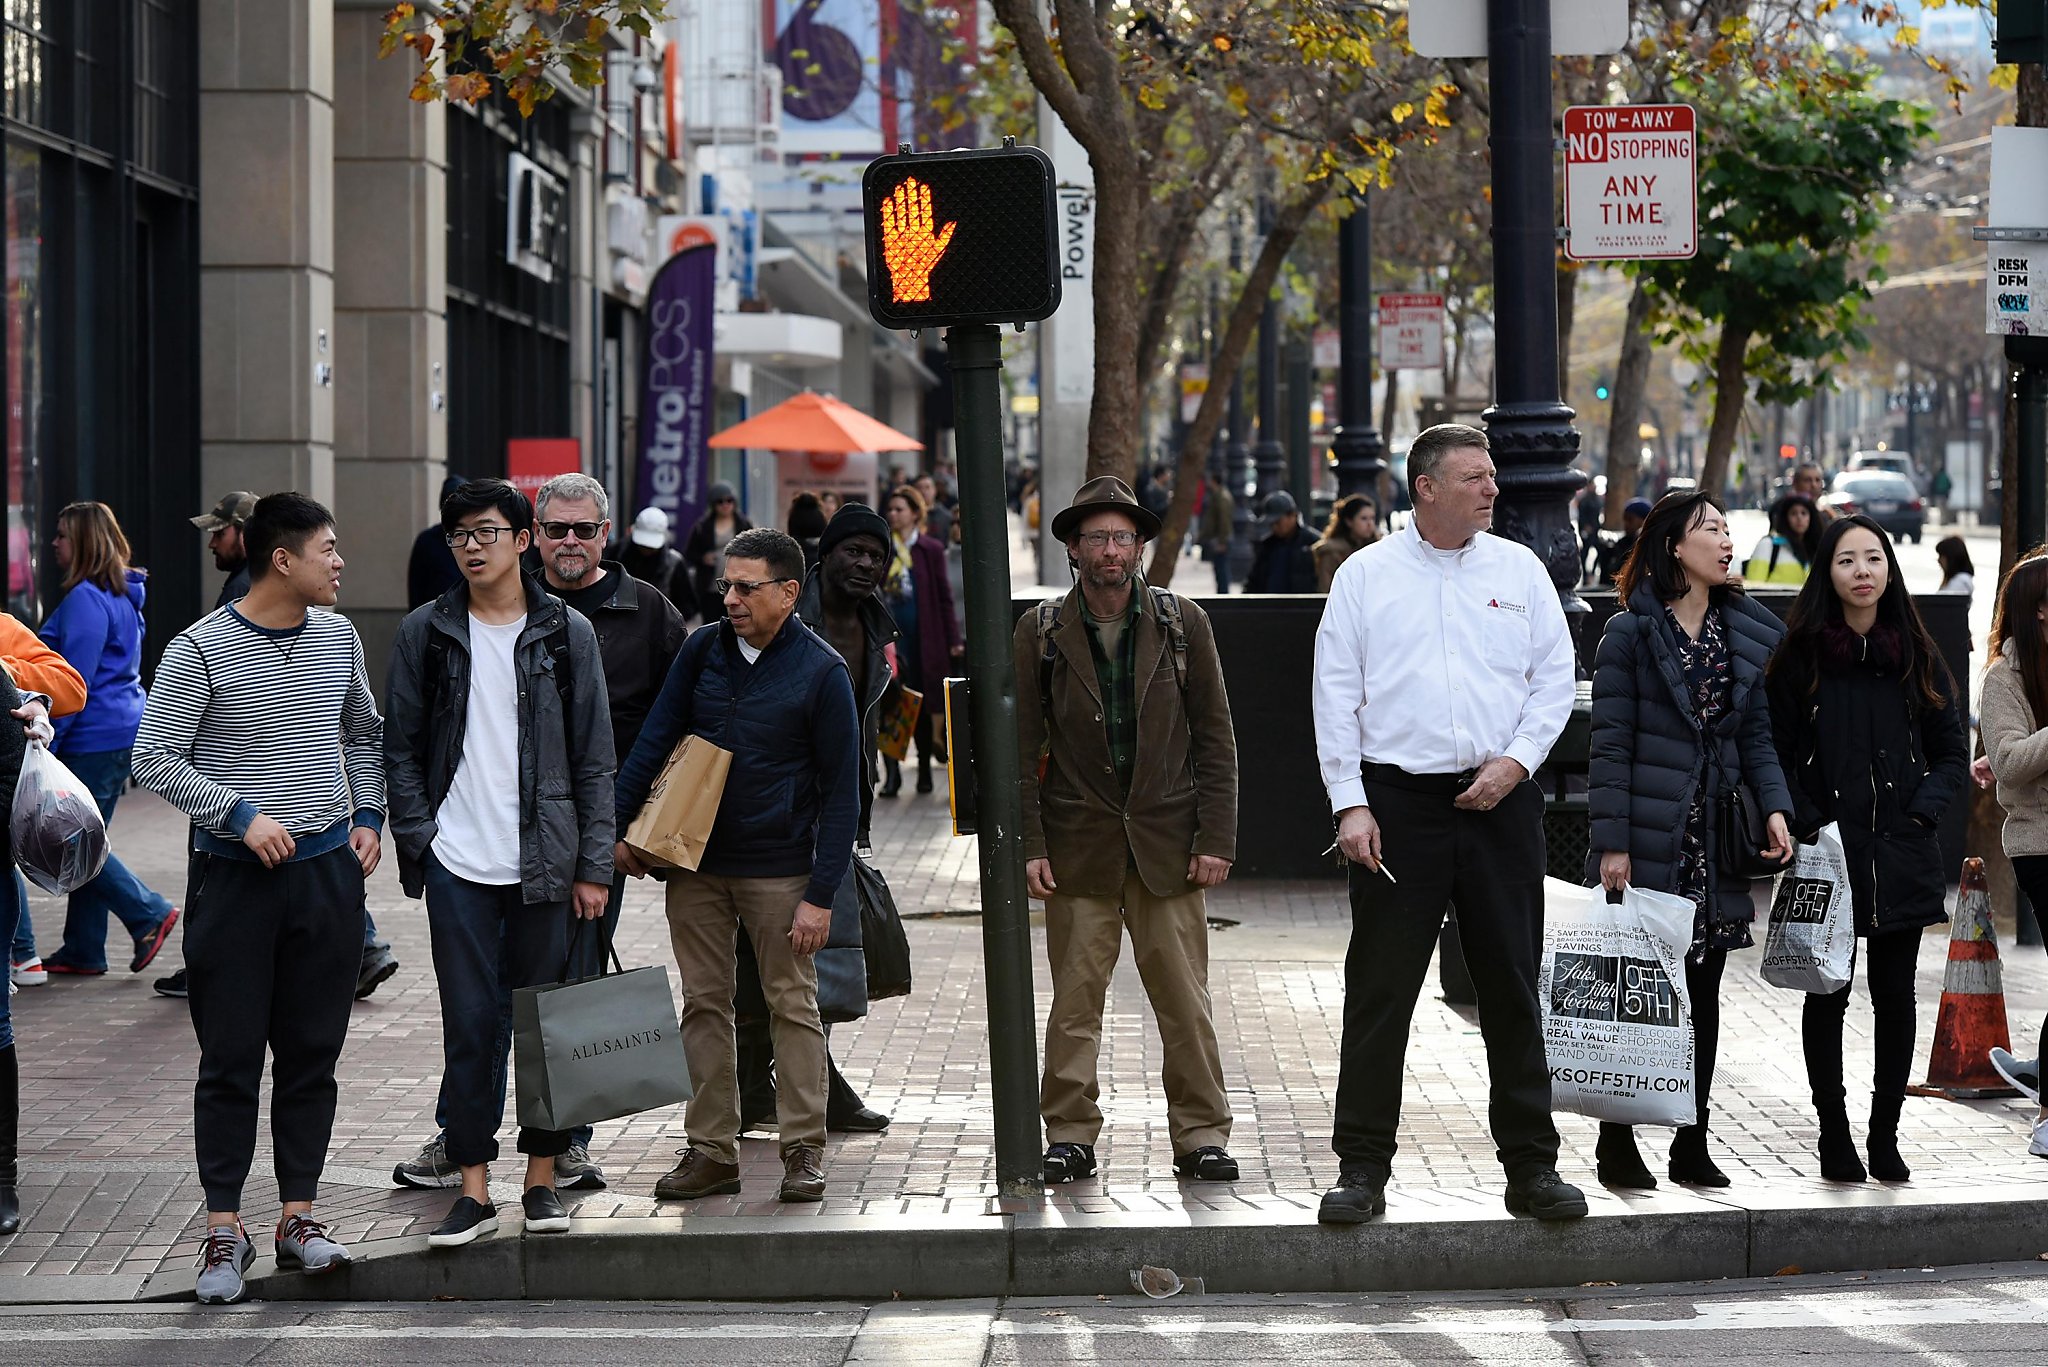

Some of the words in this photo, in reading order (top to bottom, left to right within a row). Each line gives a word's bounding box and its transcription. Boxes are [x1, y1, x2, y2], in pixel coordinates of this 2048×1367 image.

[1584, 111, 1675, 129] TOW-AWAY
[1569, 132, 1604, 161] NO
[1610, 138, 1690, 160] STOPPING
[1604, 175, 1658, 197] ANY
[1600, 202, 1664, 225] TIME
[1998, 258, 2028, 271] RESK
[1998, 275, 2028, 287] DFM
[1795, 883, 1829, 901] OFF
[1792, 900, 1825, 920] 5TH
[1824, 914, 1837, 953] MAXIMIZE
[1833, 891, 1844, 912] YOUR
[1543, 928, 1555, 954] FUN
[1556, 942, 1602, 952] SAVINGS
[1634, 934, 1650, 942] BUT
[1553, 959, 1597, 982] Saks
[1625, 965, 1670, 993] OFF
[1551, 985, 1610, 1012] Avenue
[1625, 989, 1673, 1019] 5TH
[1546, 1028, 1577, 1040] REAL
[1580, 1031, 1619, 1044] VALUE
[1620, 1035, 1680, 1050] SHOPPING
[1549, 1018, 1573, 1029] TRUE
[1576, 1021, 1620, 1034] FASHION
[1620, 1025, 1646, 1037] FEEL
[1649, 1029, 1680, 1039] GOOD
[571, 1028, 662, 1061] ALLSAINTS
[1586, 1043, 1605, 1051] SAVE
[1606, 1045, 1638, 1055] MAXIMIZE
[1640, 1048, 1659, 1056] YOUR
[1659, 1050, 1679, 1058] STYLE
[1545, 1047, 1585, 1060] STAND
[1588, 1051, 1615, 1063] OUT
[1618, 1055, 1646, 1067] AND
[1649, 1057, 1679, 1069] SAVE
[1578, 1087, 1604, 1095] FOLLOW
